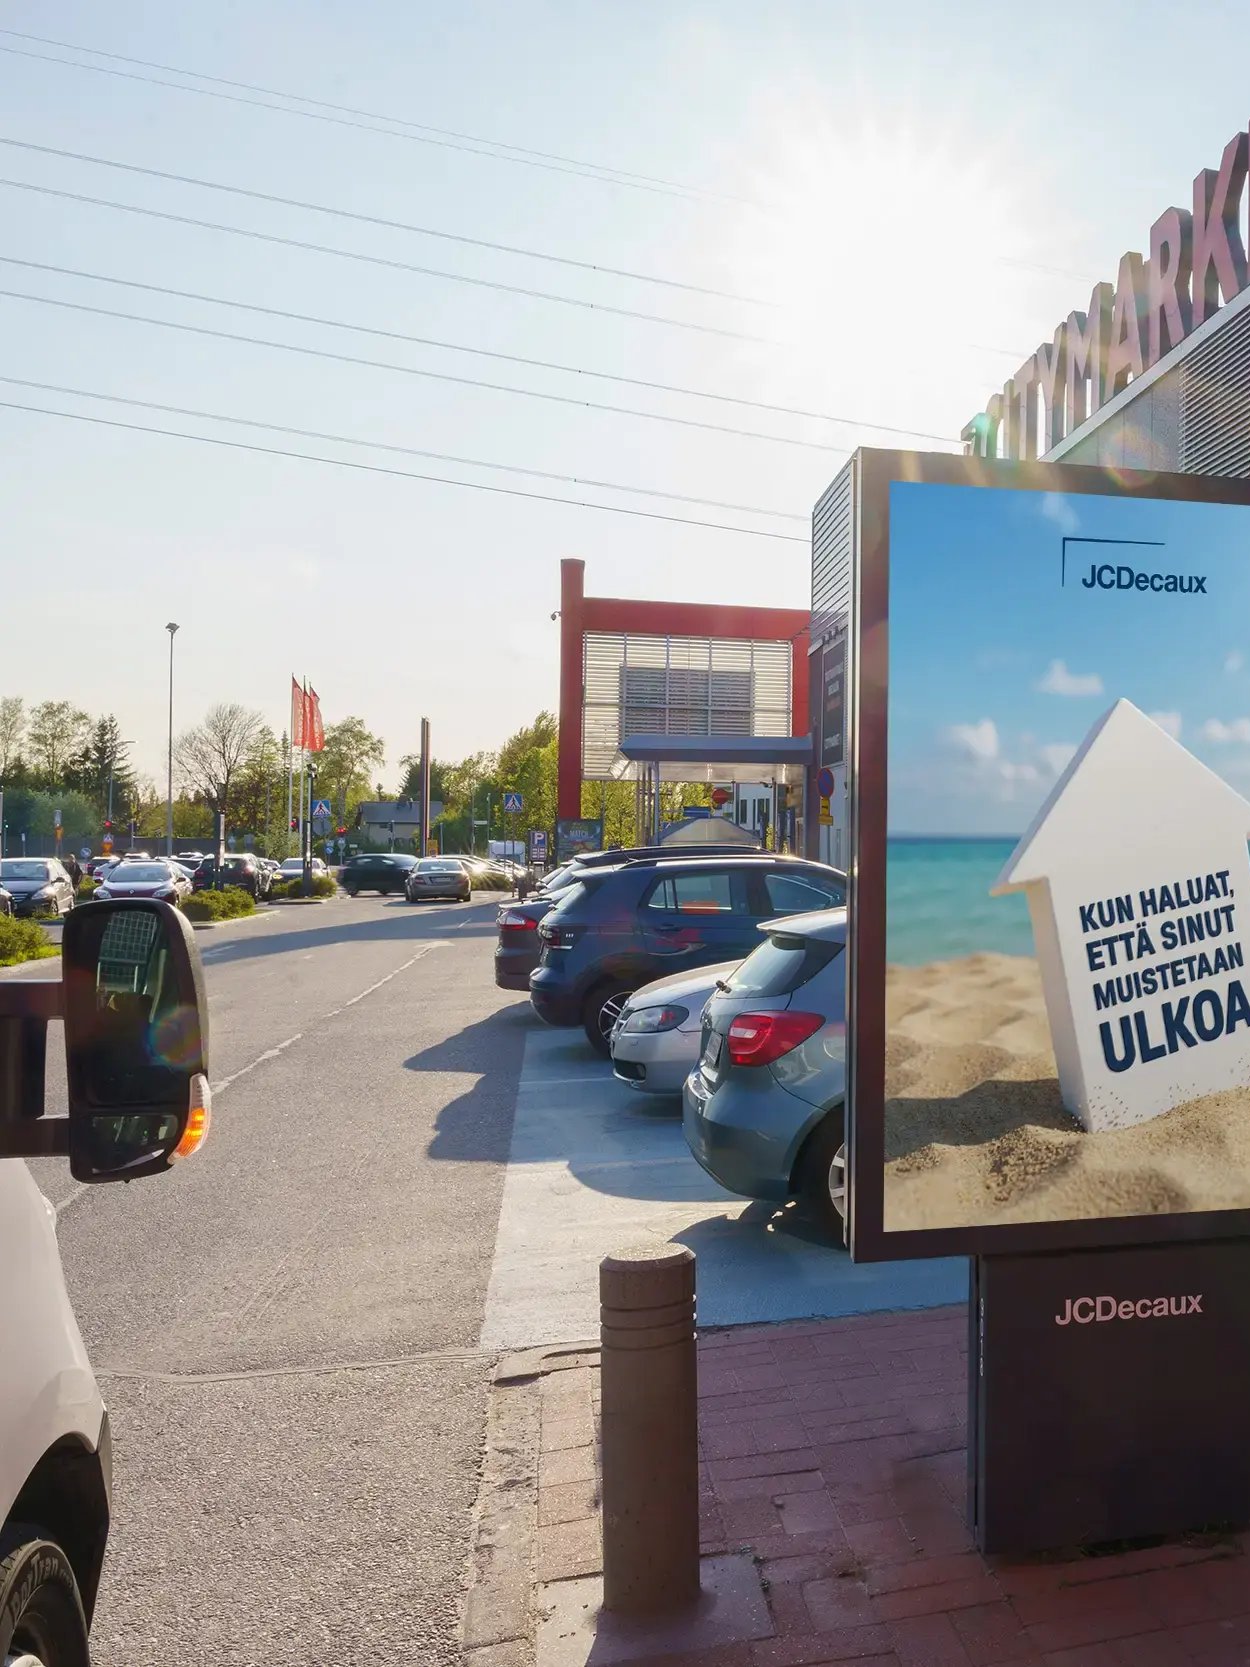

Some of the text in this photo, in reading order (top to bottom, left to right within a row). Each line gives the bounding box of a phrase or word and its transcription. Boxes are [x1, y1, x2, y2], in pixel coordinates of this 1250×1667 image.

[1081, 564, 1208, 594] JCDecaux
[1079, 870, 1235, 933] KUN HALUAT,
[1086, 904, 1236, 972] ETTÄ SINUT
[1093, 942, 1244, 1011] MUISTETAAN
[1055, 1294, 1204, 1326] JCDecaux
